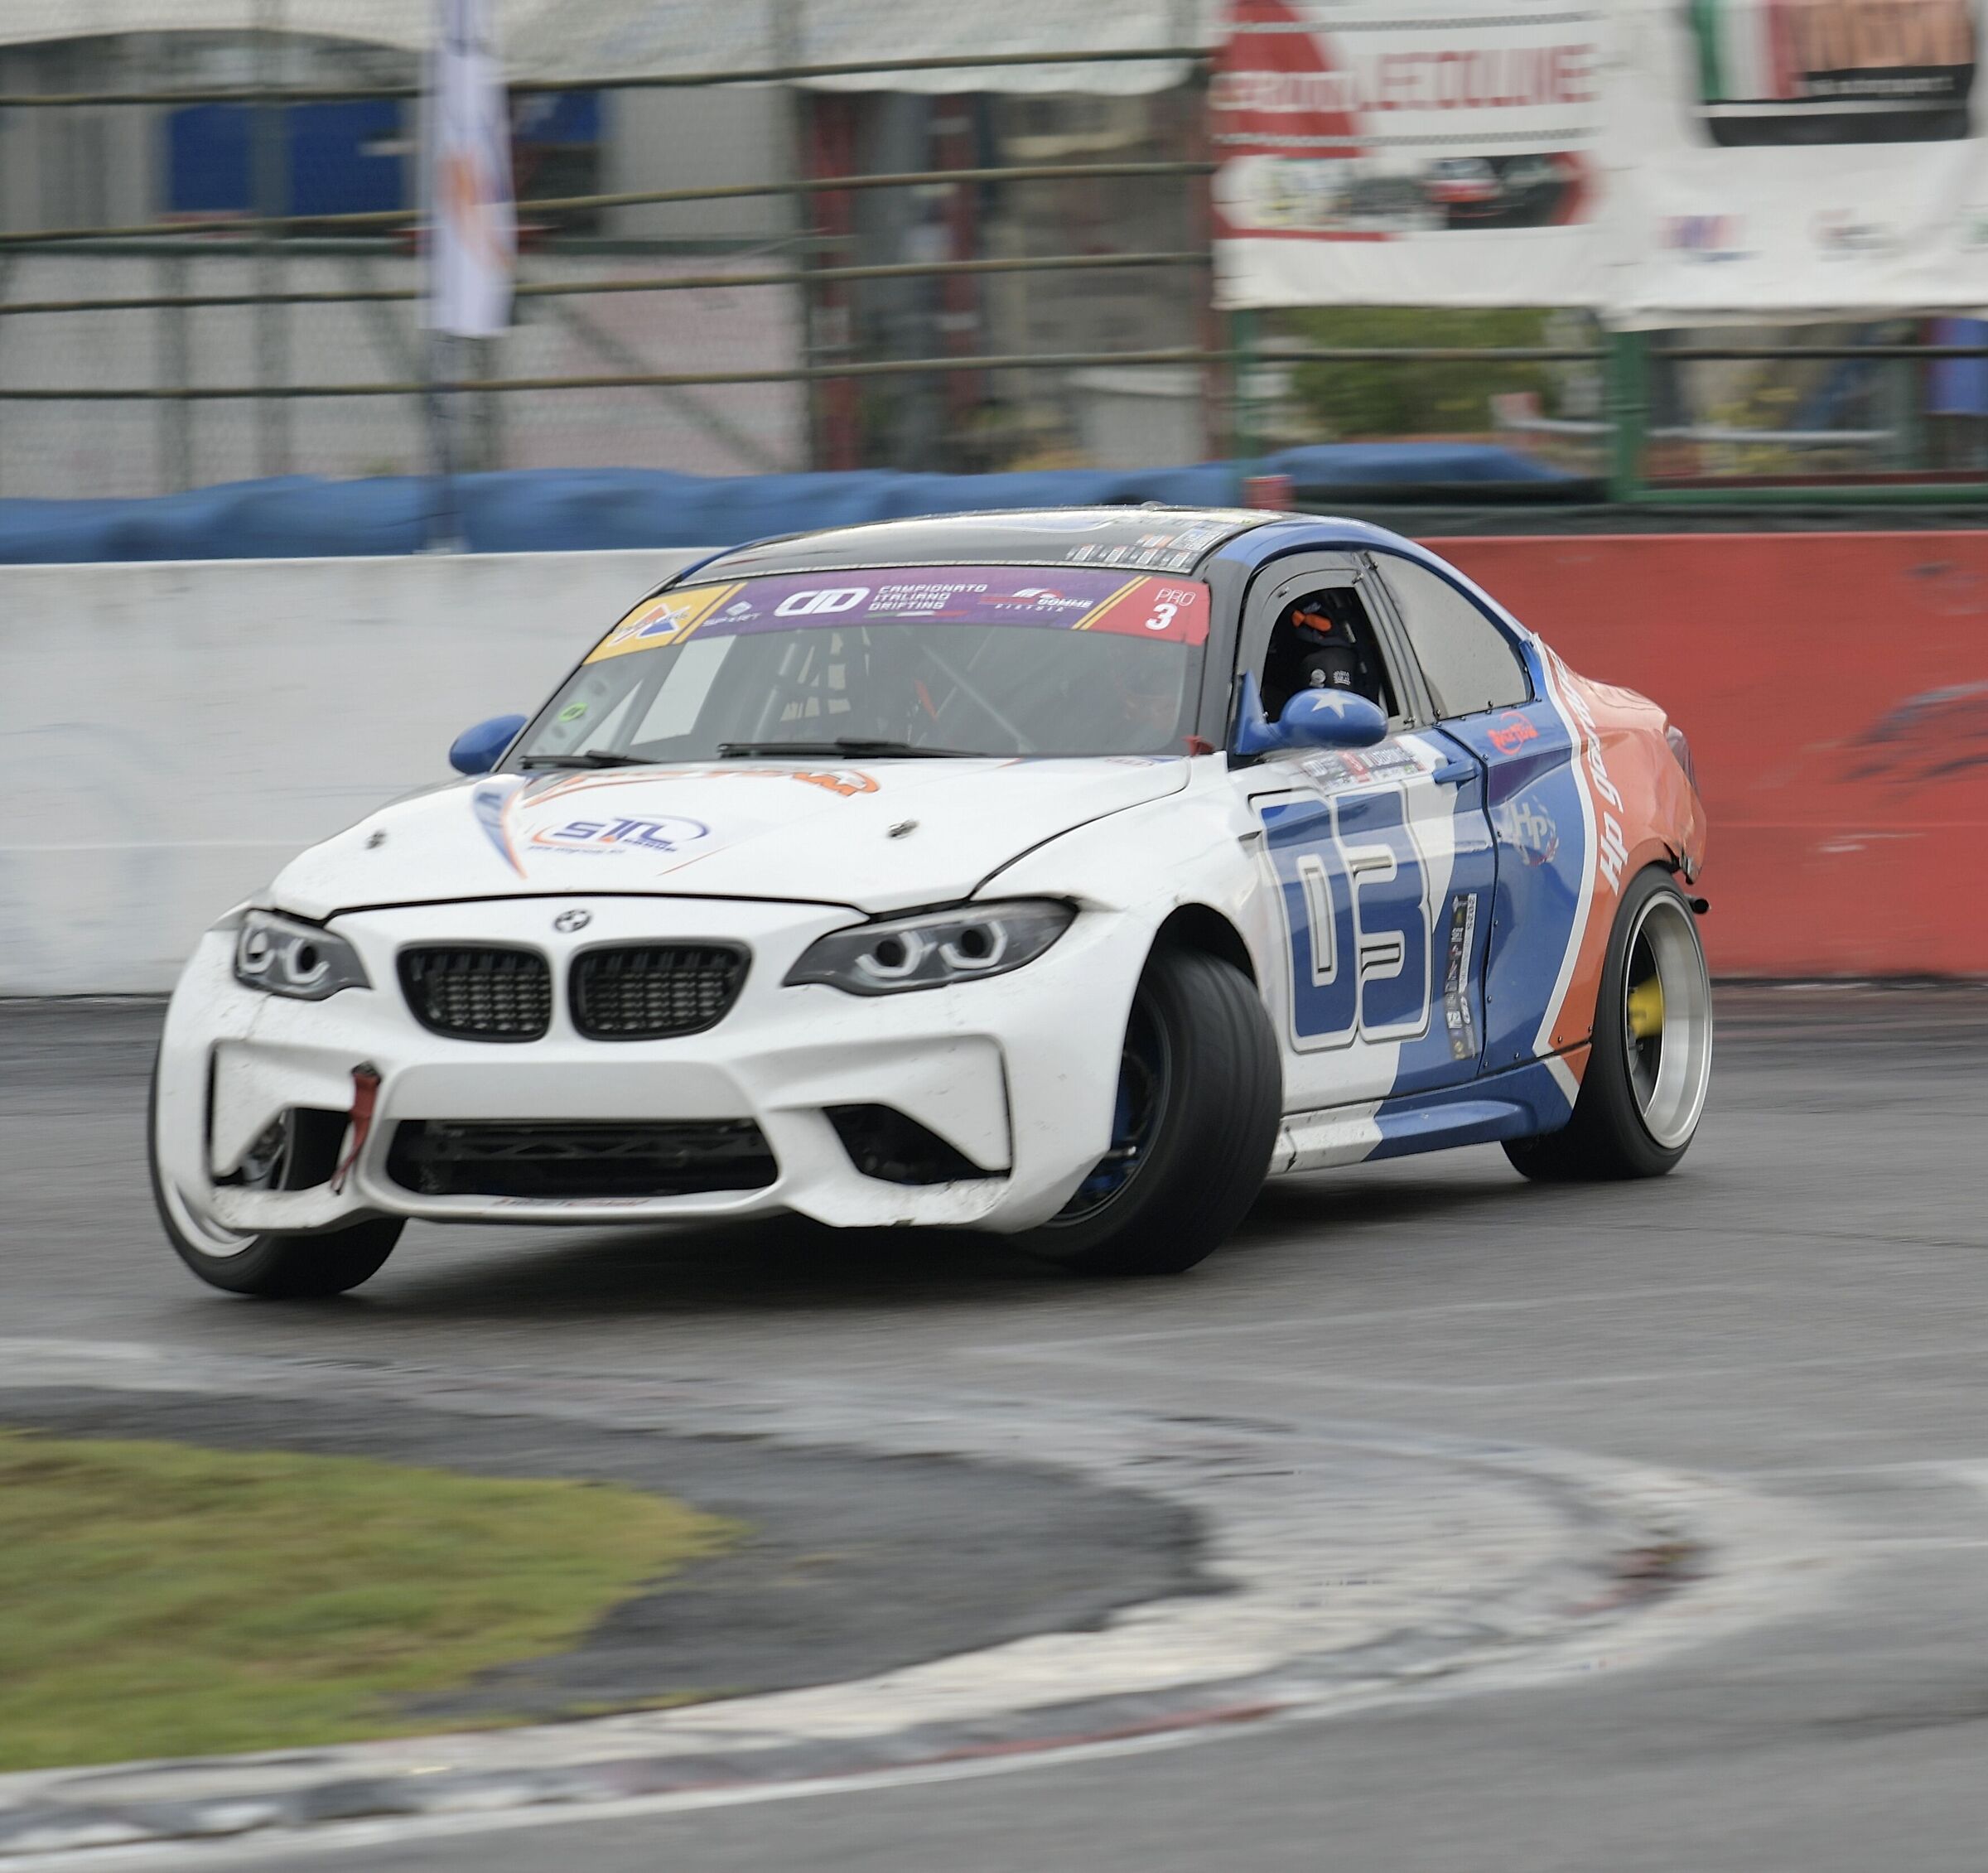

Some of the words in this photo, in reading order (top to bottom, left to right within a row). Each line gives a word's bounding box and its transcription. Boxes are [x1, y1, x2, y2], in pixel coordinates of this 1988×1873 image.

[878, 583, 987, 594] CAMPIONATO
[873, 592, 951, 602] ITALIANO
[1154, 587, 1197, 606] PRO
[868, 601, 946, 611] DRIFTING
[1145, 603, 1178, 630] 3
[1254, 786, 1431, 1049] 03
